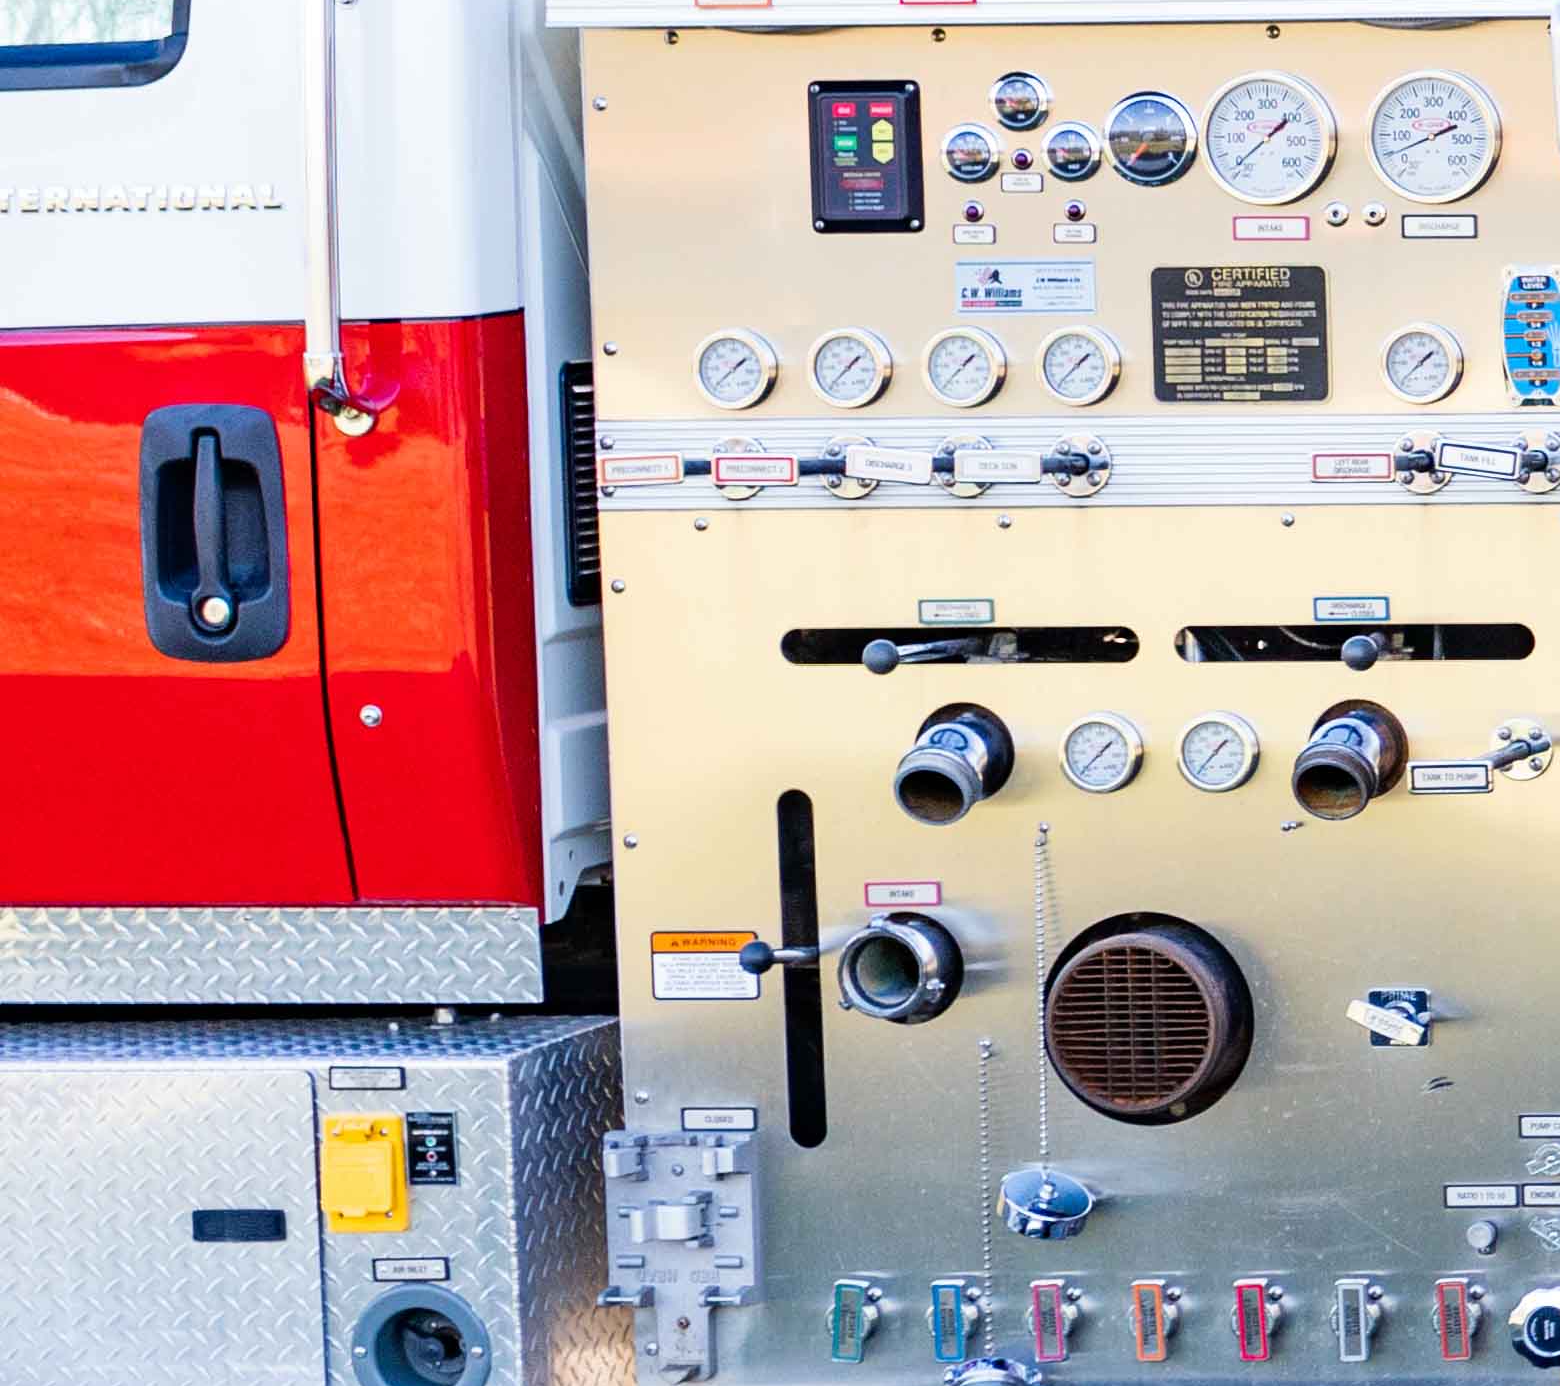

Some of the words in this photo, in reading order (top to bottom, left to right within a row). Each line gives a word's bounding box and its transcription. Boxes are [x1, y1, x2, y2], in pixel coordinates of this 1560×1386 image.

[1257, 99, 1278, 109] 300
[1424, 97, 1443, 107] 300
[1234, 110, 1255, 121] 200
[1400, 108, 1420, 119] 200
[1447, 110, 1467, 121] 400
[1227, 133, 1245, 143] 100
[1393, 130, 1411, 141] 100
[1452, 134, 1472, 145] 500
[1286, 136, 1306, 146] 500
[1282, 157, 1301, 167] 600
[1401, 153, 1408, 164] 0
[1448, 155, 1467, 165] 600
[1211, 268, 1290, 280] CERTIFIED
[1213, 280, 1233, 288] FIRE
[1236, 280, 1290, 288] APPARATUS
[1422, 772, 1441, 781] TANK
[1444, 772, 1454, 781] TO
[1456, 772, 1478, 781] PUMP
[682, 938, 737, 947] WARNING
[1380, 990, 1417, 1001] PRIME
[1530, 1122, 1550, 1131] PUMP
[1530, 1191, 1555, 1199] ENGINE
[392, 1265, 406, 1274] AIR
[408, 1265, 427, 1274] INLET
